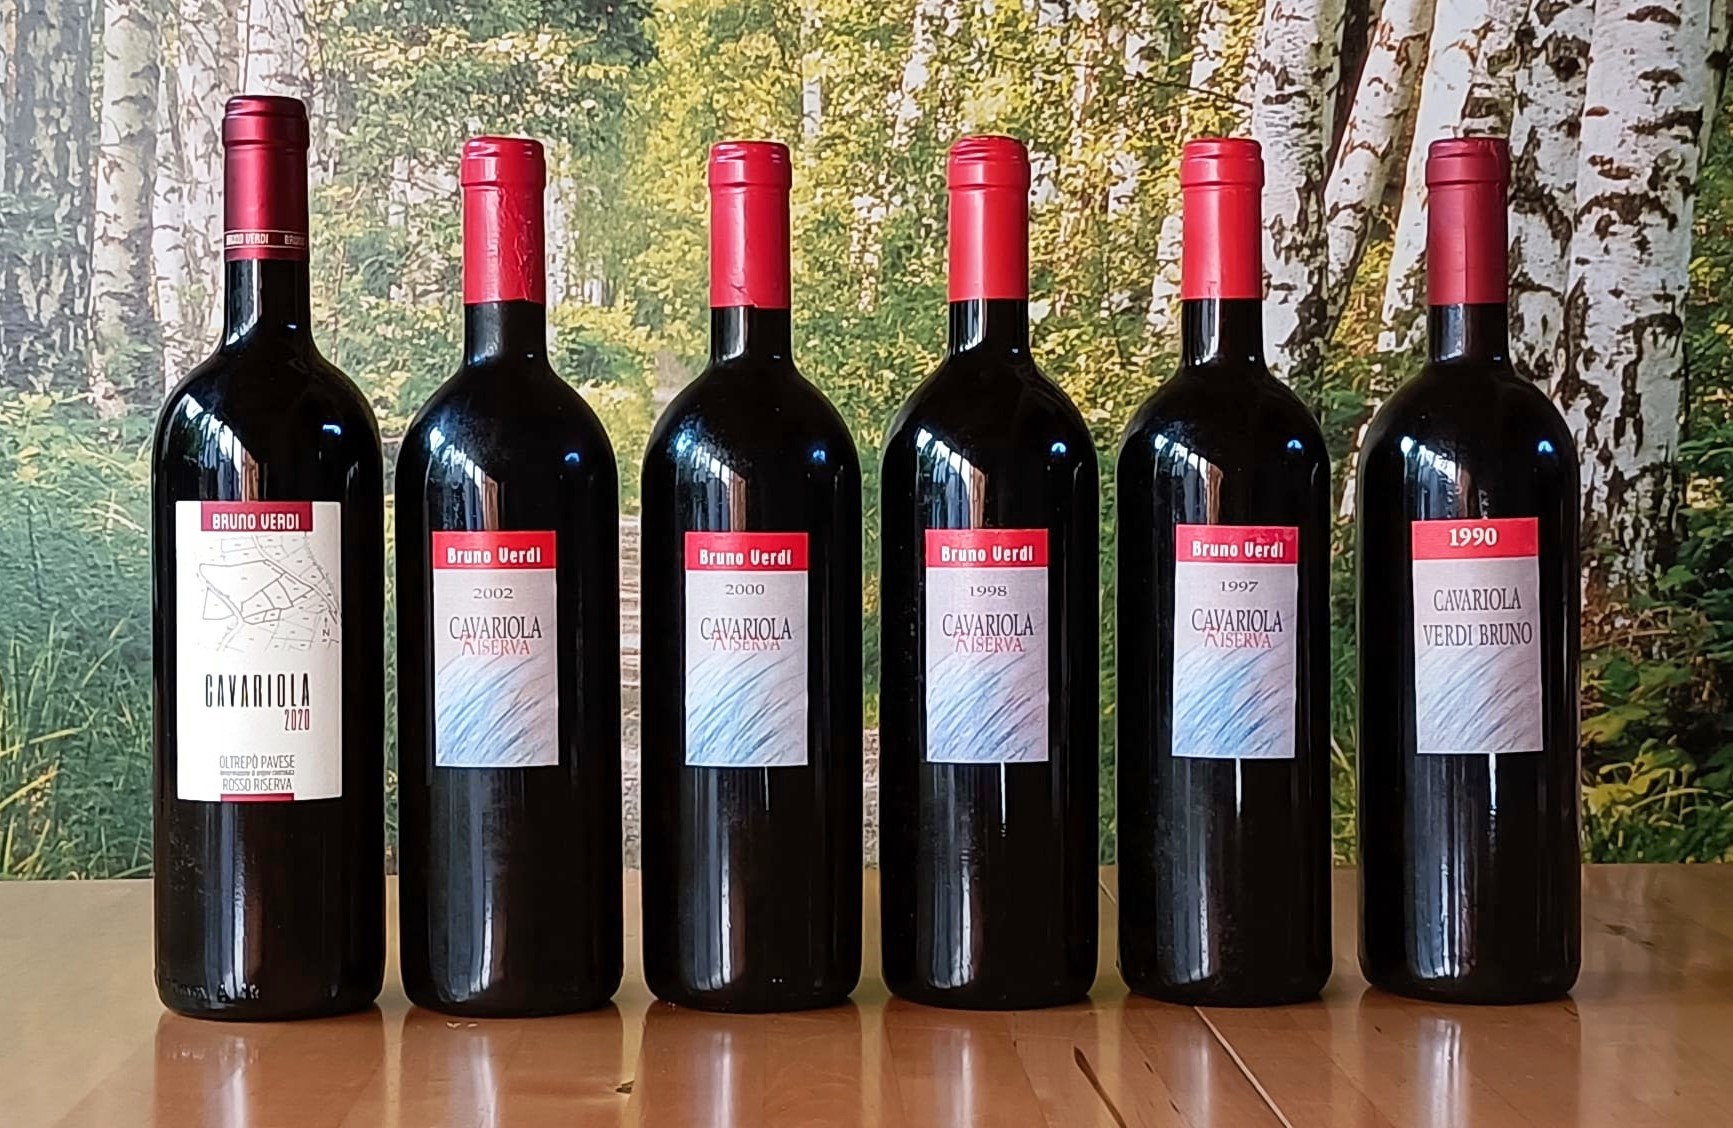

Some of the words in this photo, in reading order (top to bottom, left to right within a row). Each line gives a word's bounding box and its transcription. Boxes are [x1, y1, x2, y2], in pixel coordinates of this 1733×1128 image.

[245, 233, 269, 245] VERDI
[212, 513, 256, 530] BRUNO
[260, 513, 300, 530] VERDI
[1449, 527, 1497, 547] 1990
[447, 547, 492, 564] Bruno
[498, 546, 541, 564] Verdi
[699, 549, 744, 566] Bruno
[750, 549, 792, 566] Verdi
[941, 545, 987, 562] Bruno
[992, 545, 1034, 562] Verdi
[1192, 540, 1238, 557] Bruno
[1244, 541, 1284, 558] Verdi
[473, 588, 514, 599] 2002
[725, 584, 765, 595] 2000
[970, 585, 1007, 597] 1998
[1220, 581, 1258, 592] 1997
[1433, 587, 1522, 611] CAVARIOLA
[449, 616, 543, 640] CAVARIOLA
[700, 617, 792, 640] CAVARIOLA
[942, 613, 1034, 637] CAVARIOLA
[1191, 608, 1283, 633] CAVARIOLA
[954, 632, 1025, 653] RISERVA
[1202, 627, 1272, 649] RISERVA
[1422, 624, 1473, 647] VERDI
[1479, 622, 1533, 646] BRUNO
[460, 634, 531, 656] RISERVA
[205, 673, 310, 708] CAVARIOLA
[284, 709, 310, 731] 2020
[260, 754, 295, 769] PAVESE
[222, 778, 251, 792] ROSSO
[253, 777, 293, 791] RISERVA
